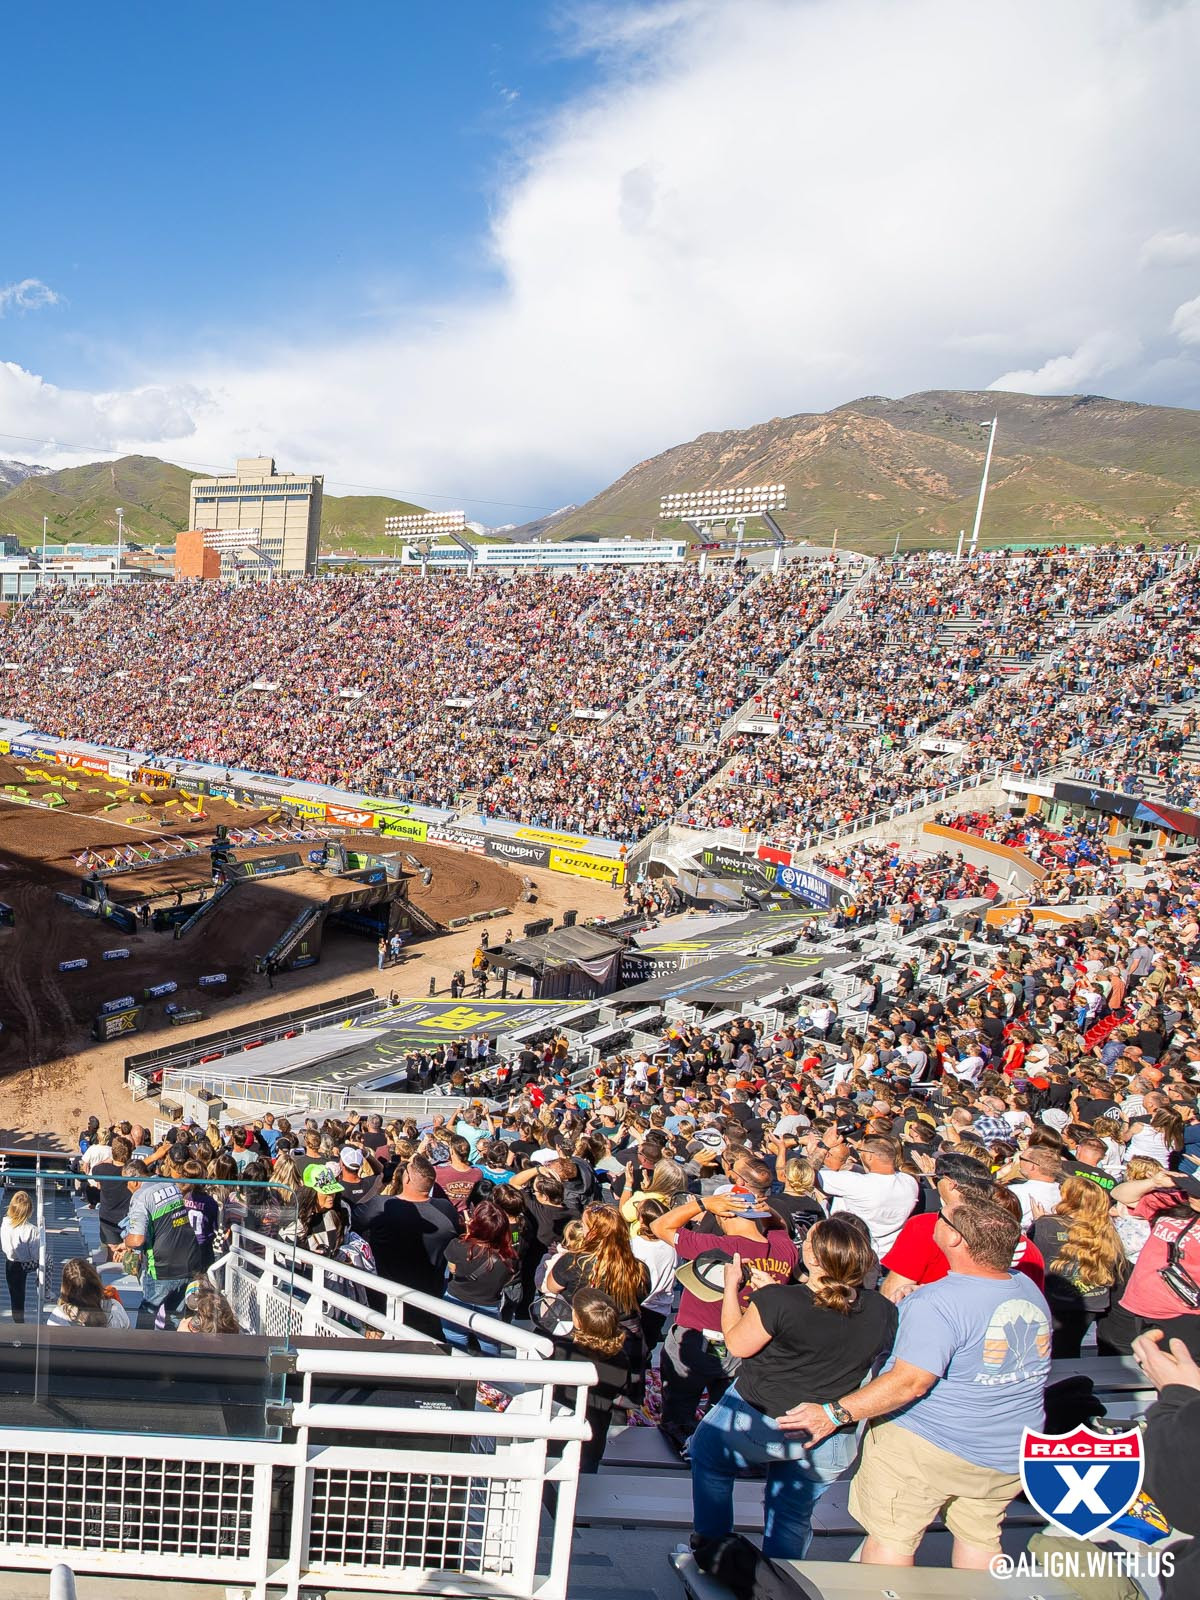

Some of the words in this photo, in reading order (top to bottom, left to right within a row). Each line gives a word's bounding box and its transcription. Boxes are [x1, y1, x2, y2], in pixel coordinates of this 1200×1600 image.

[751, 725, 763, 733] 39
[934, 742, 946, 751] 41
[209, 783, 236, 794] GoPro
[531, 832, 585, 846] DUNLOP
[490, 841, 533, 859] TRIUMPH
[715, 856, 761, 874] MONSTER
[785, 883, 827, 904] RACING
[795, 872, 828, 899] YAMAHA
[637, 960, 678, 969] SPORTS
[1074, 1170, 1115, 1190] TOMAC
[1153, 1224, 1191, 1249] EAGE
